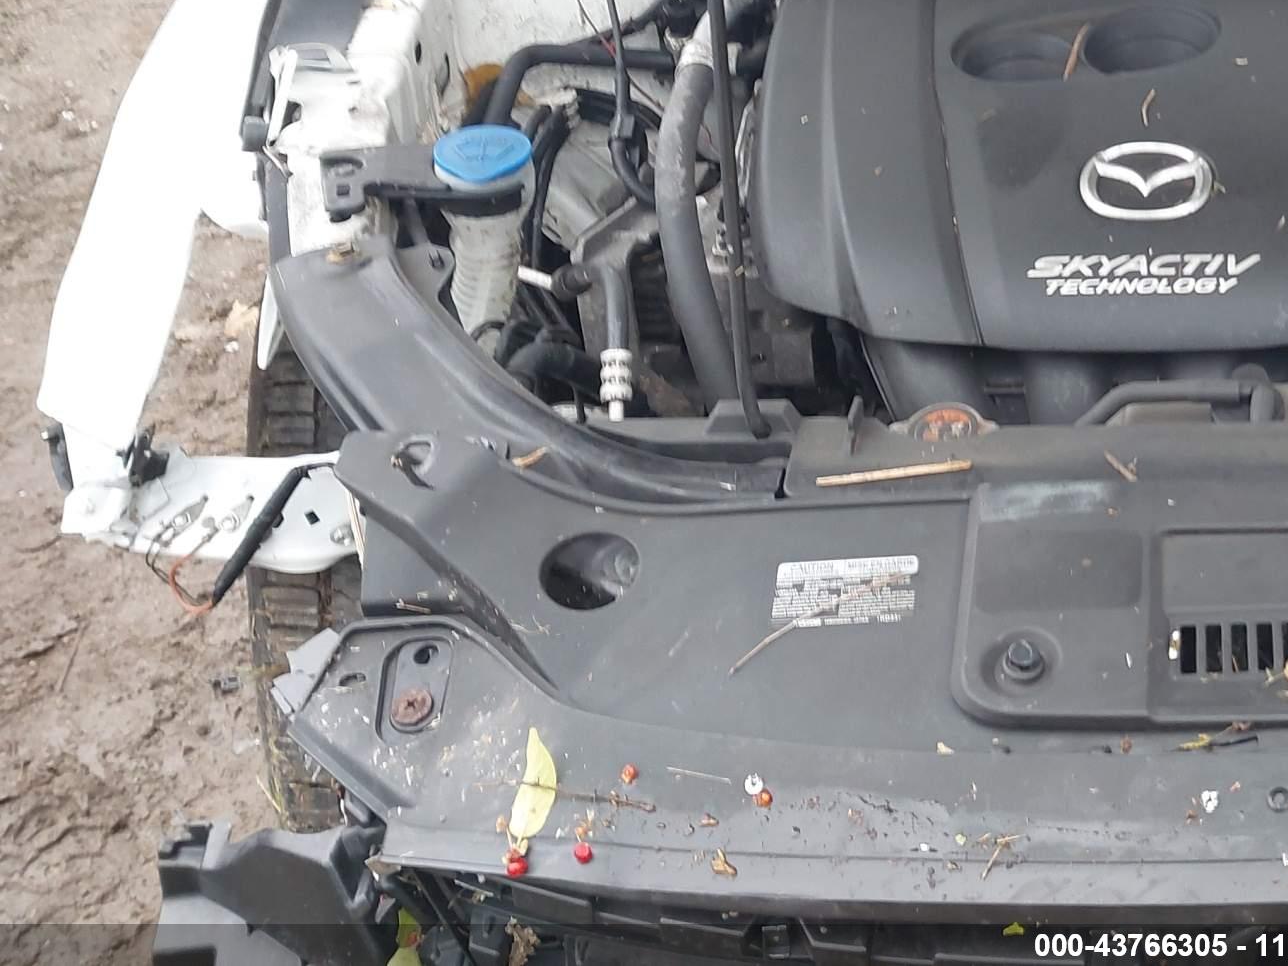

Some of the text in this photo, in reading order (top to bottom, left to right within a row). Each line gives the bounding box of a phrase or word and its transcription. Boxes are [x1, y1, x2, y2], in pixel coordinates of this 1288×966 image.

[1027, 253, 1261, 278] SKYACTIV
[1045, 277, 1239, 296] TECHNOLOGY
[790, 561, 834, 575] CAUTION
